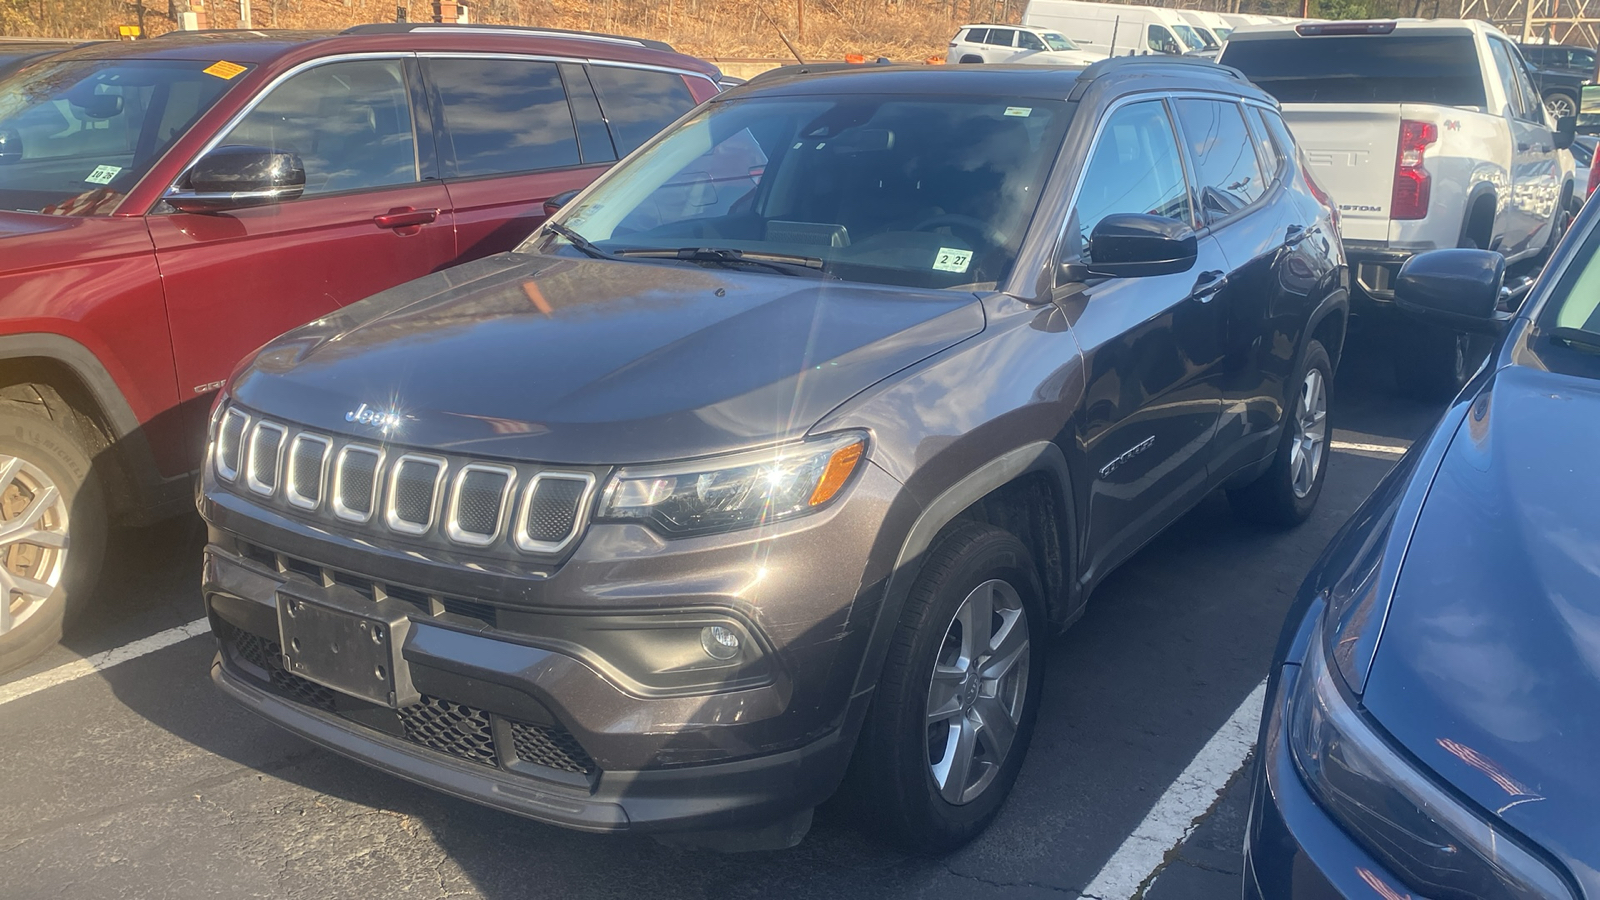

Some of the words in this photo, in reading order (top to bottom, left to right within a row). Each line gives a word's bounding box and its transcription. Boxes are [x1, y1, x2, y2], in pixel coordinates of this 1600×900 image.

[92, 170, 104, 178] 10
[940, 254, 949, 264] 2
[953, 255, 967, 266] 27
[345, 403, 401, 434] Jeep
